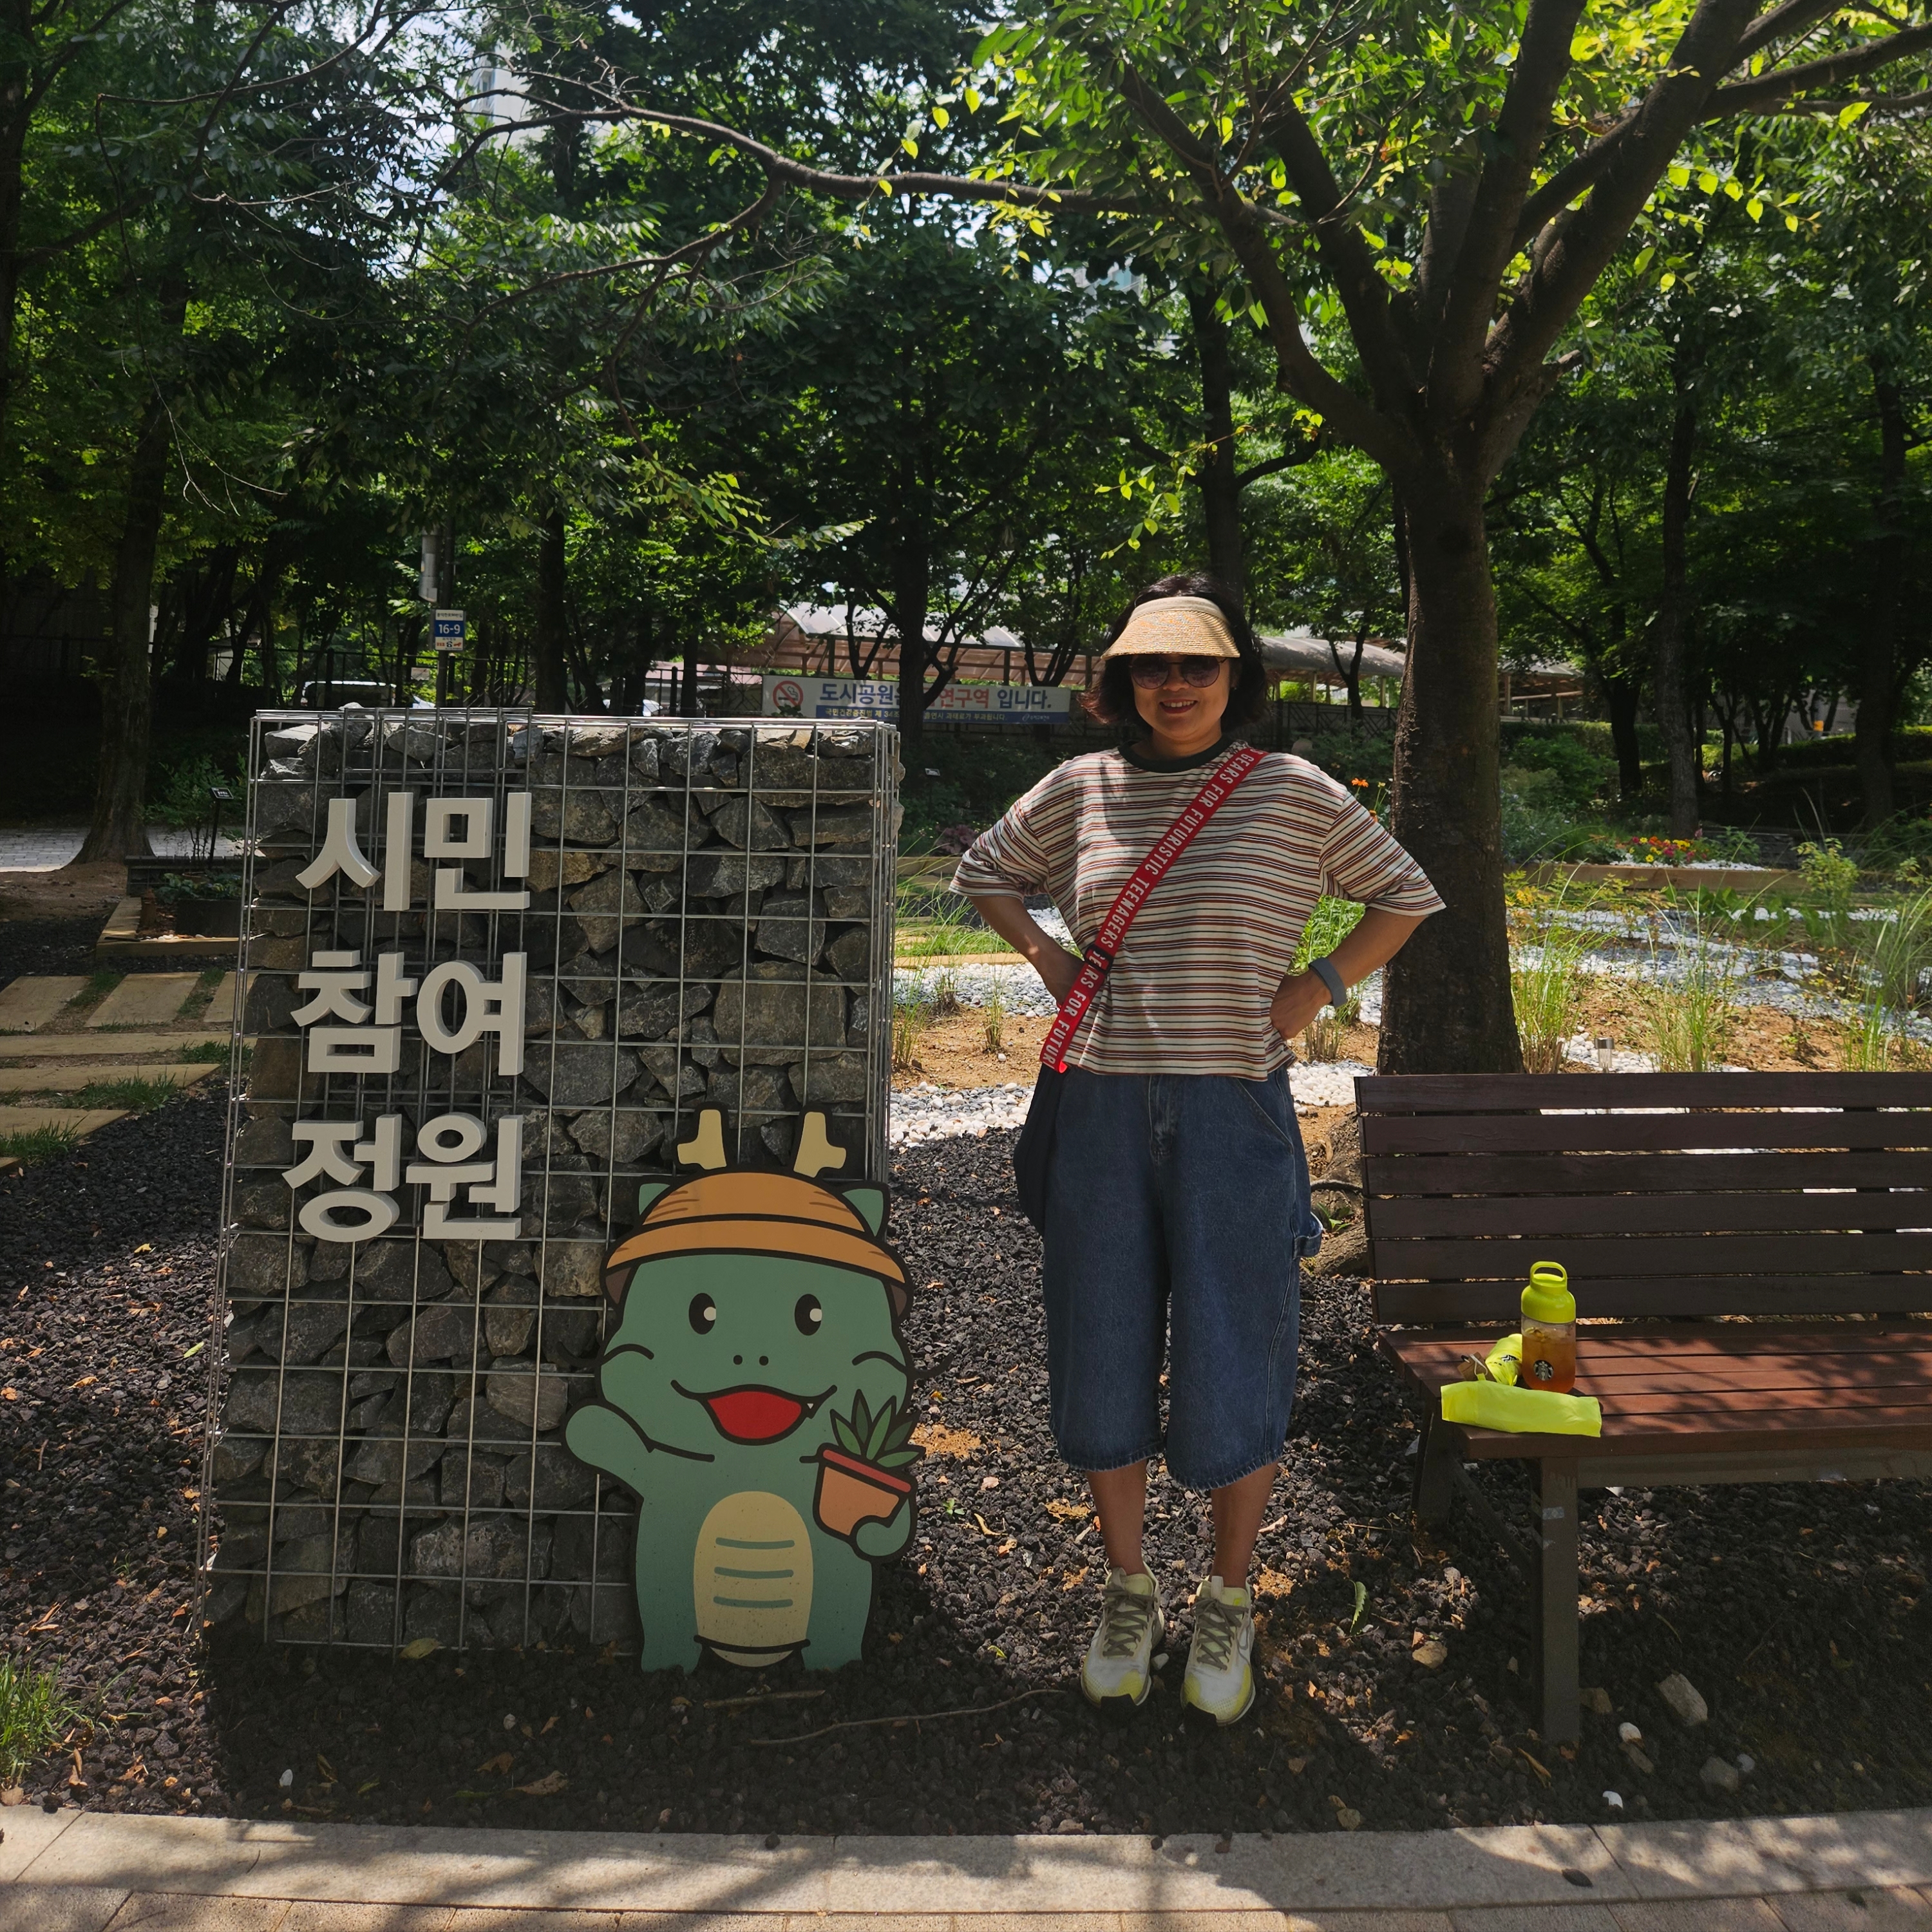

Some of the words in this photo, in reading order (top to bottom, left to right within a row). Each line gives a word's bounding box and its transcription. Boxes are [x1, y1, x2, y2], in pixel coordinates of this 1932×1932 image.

[439, 623, 461, 634] 16-9
[825, 708, 873, 717] 국민건강증진법
[875, 710, 882, 718] 제
[945, 712, 972, 721] 과태료가
[997, 689, 1052, 710] 입니다.
[1219, 753, 1255, 784] GEARS
[1198, 783, 1225, 808] FOR
[295, 792, 532, 912] 시민
[1144, 808, 1204, 875] FUTURISTIC
[1101, 877, 1150, 949] TEENAGERS
[290, 949, 527, 1076] 참여
[1064, 990, 1086, 1018] FOR
[281, 1112, 524, 1242] 정원
